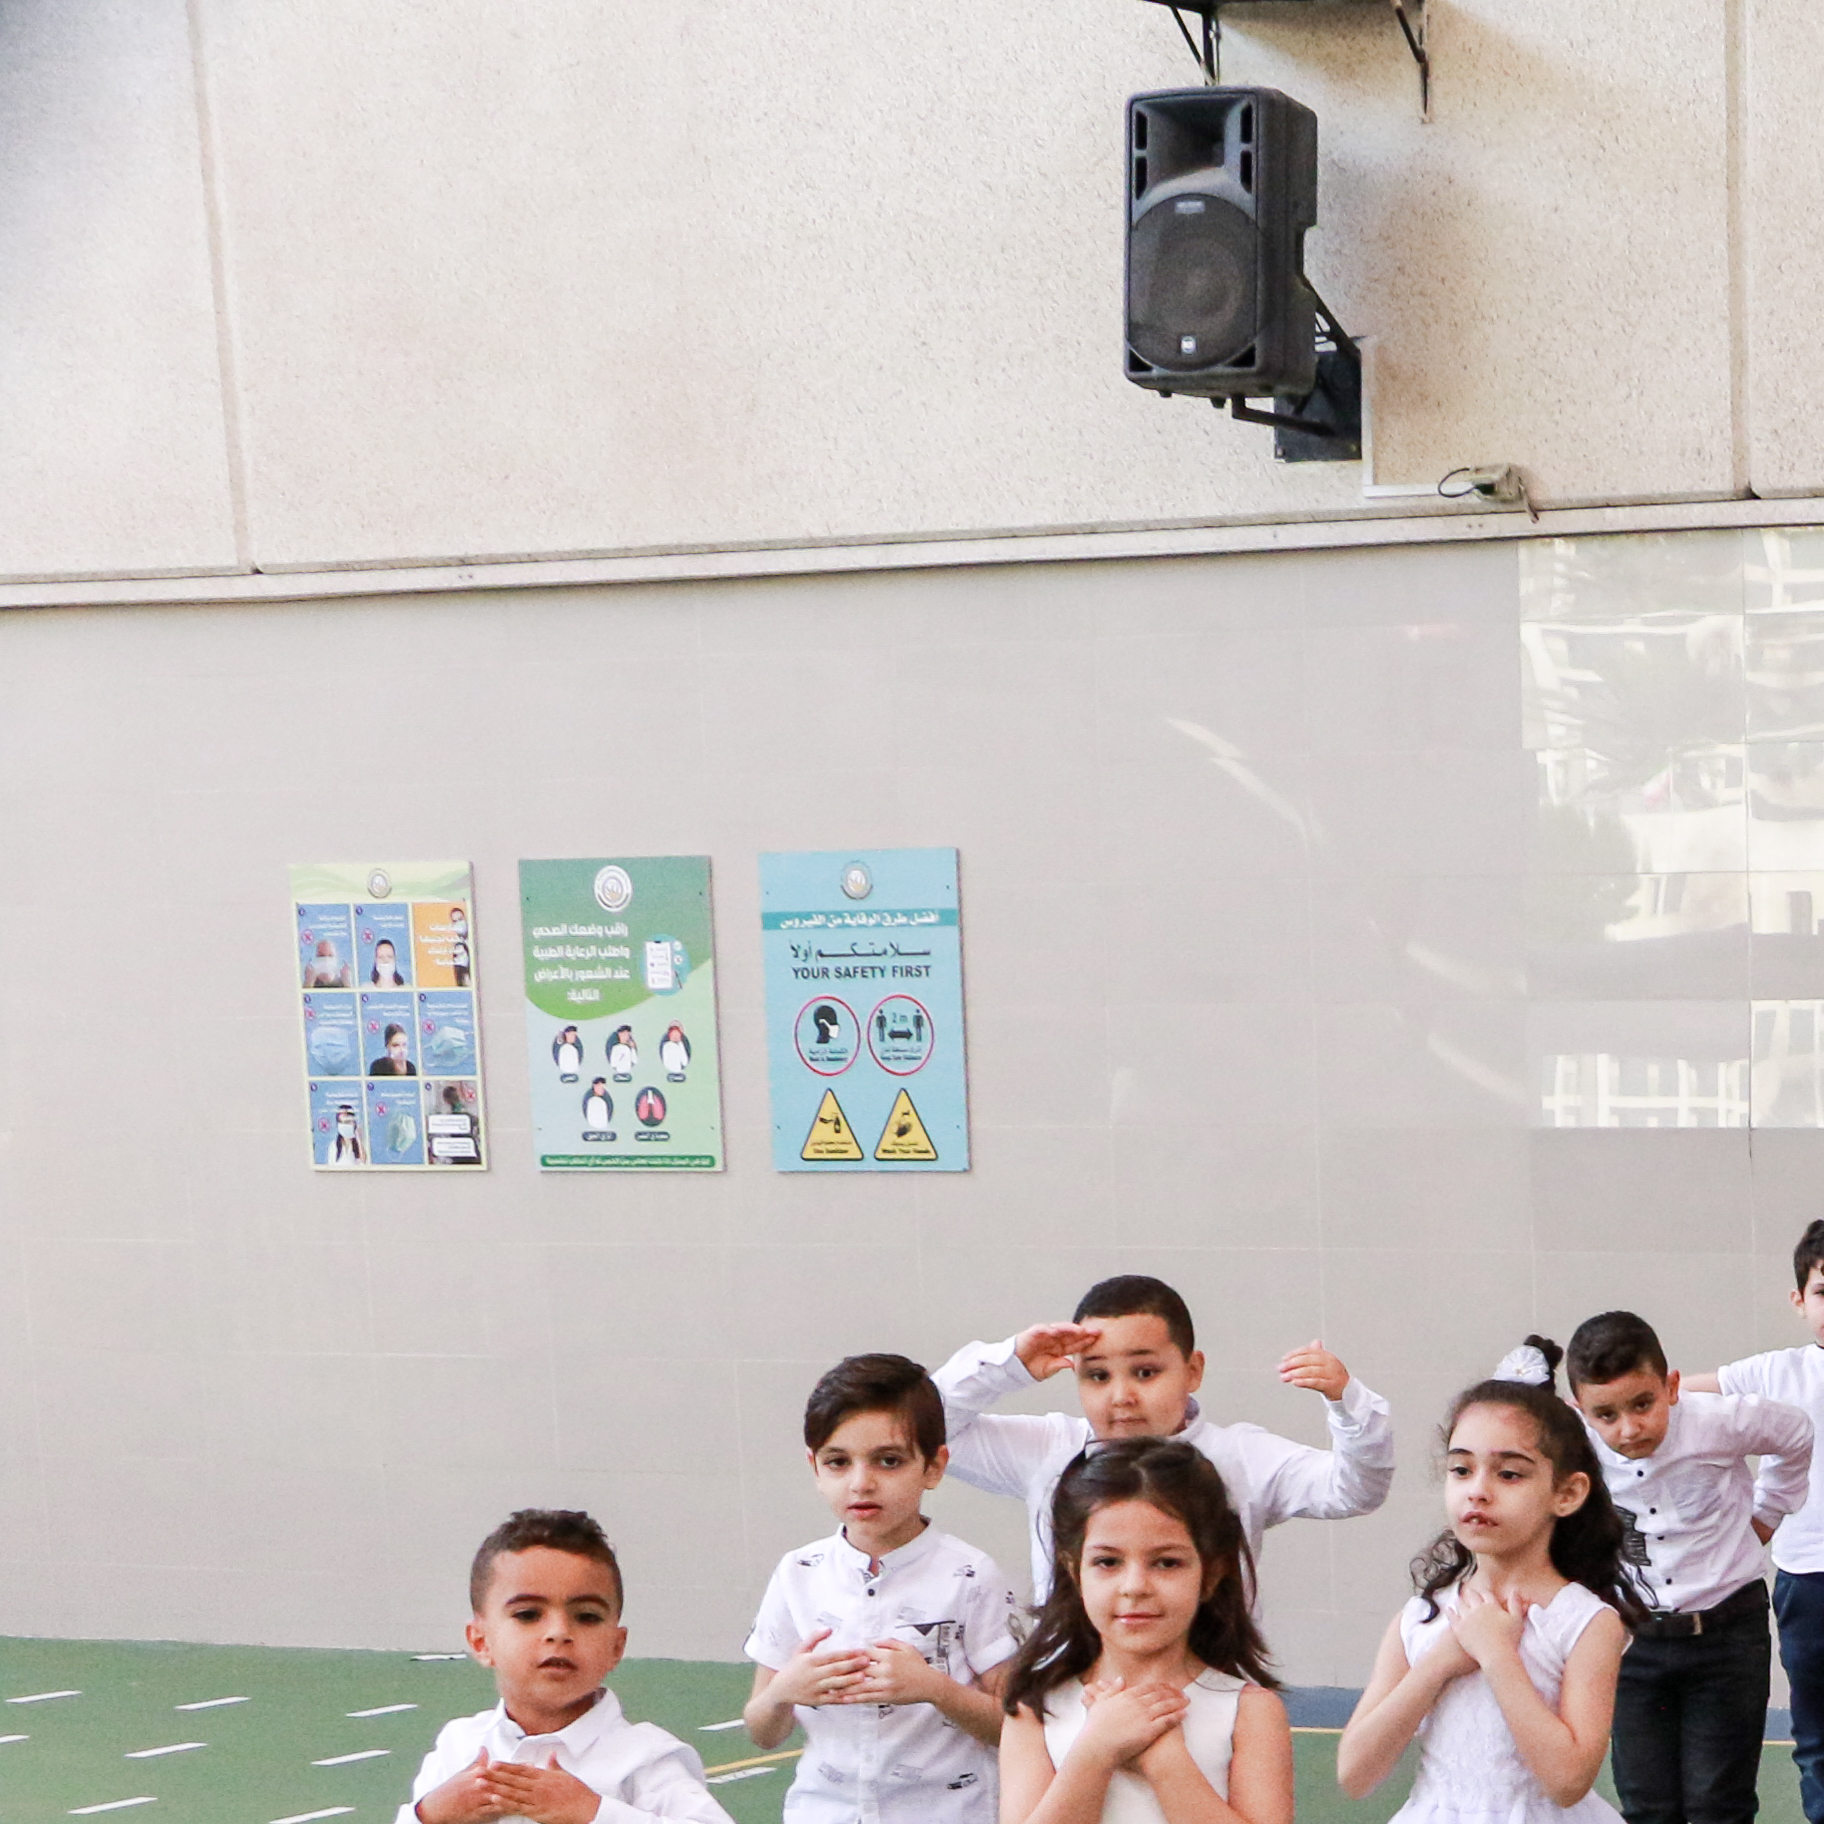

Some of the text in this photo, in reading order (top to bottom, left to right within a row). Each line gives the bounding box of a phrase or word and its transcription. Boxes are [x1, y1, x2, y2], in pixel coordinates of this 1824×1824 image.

[792, 964, 931, 980] YOUR SAFETY FIRST
